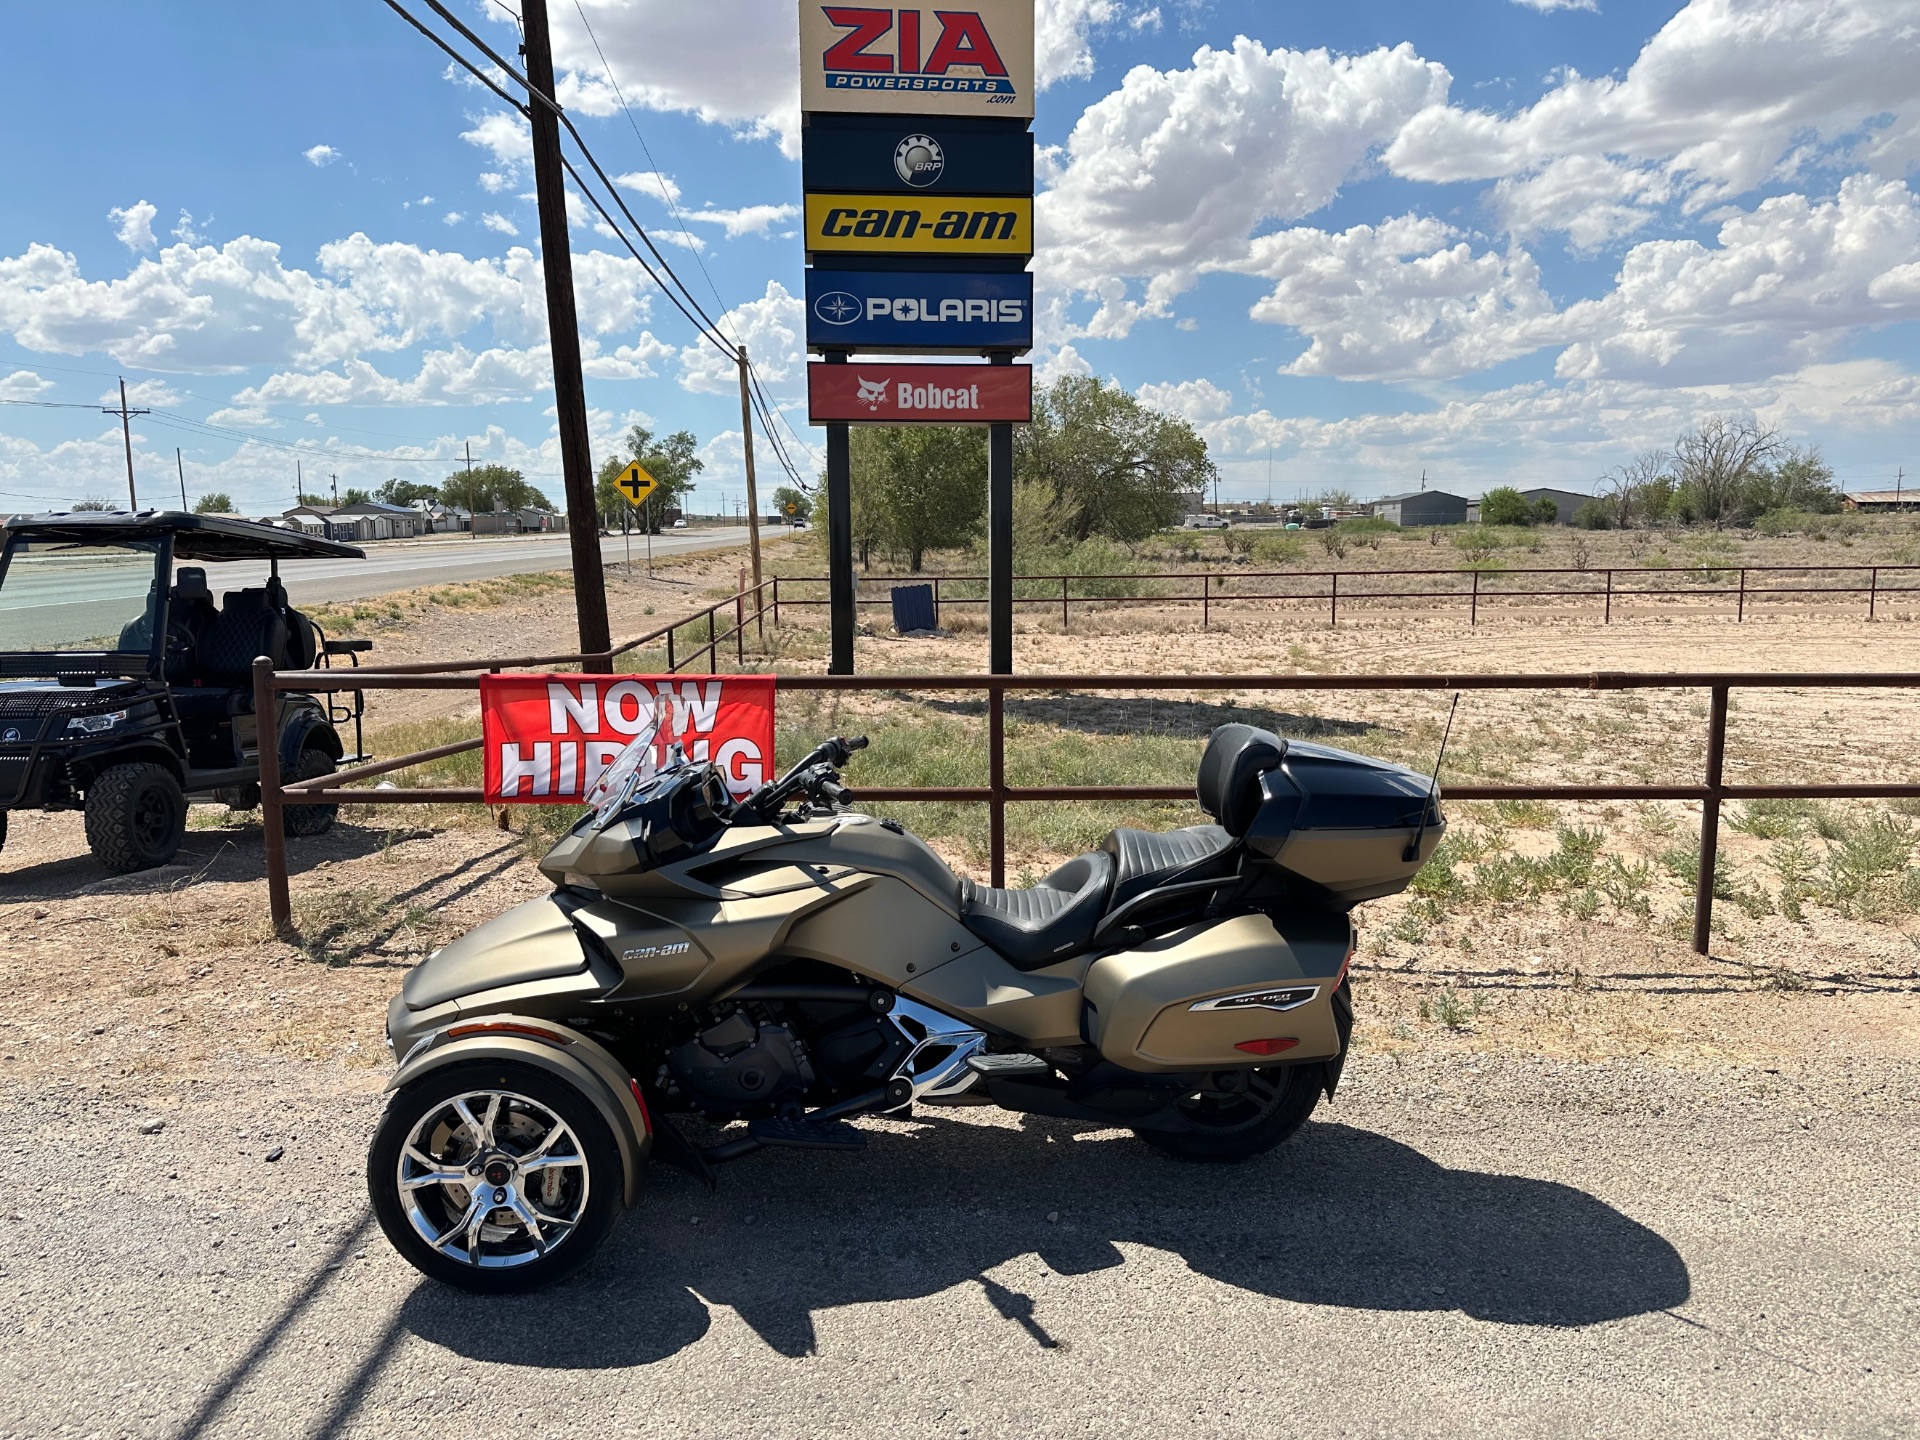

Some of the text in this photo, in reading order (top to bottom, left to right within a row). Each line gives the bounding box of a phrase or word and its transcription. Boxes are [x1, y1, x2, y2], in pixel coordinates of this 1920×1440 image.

[821, 6, 1009, 77] ZIA
[835, 77, 998, 92] POWERSPORTS
[986, 94, 1016, 104] .com
[914, 162, 942, 171] BRP
[821, 208, 1018, 240] can-am
[866, 297, 1023, 323] POLARIS
[897, 382, 979, 410] Bobcat
[548, 680, 722, 735] NOW
[622, 942, 690, 961] can-am
